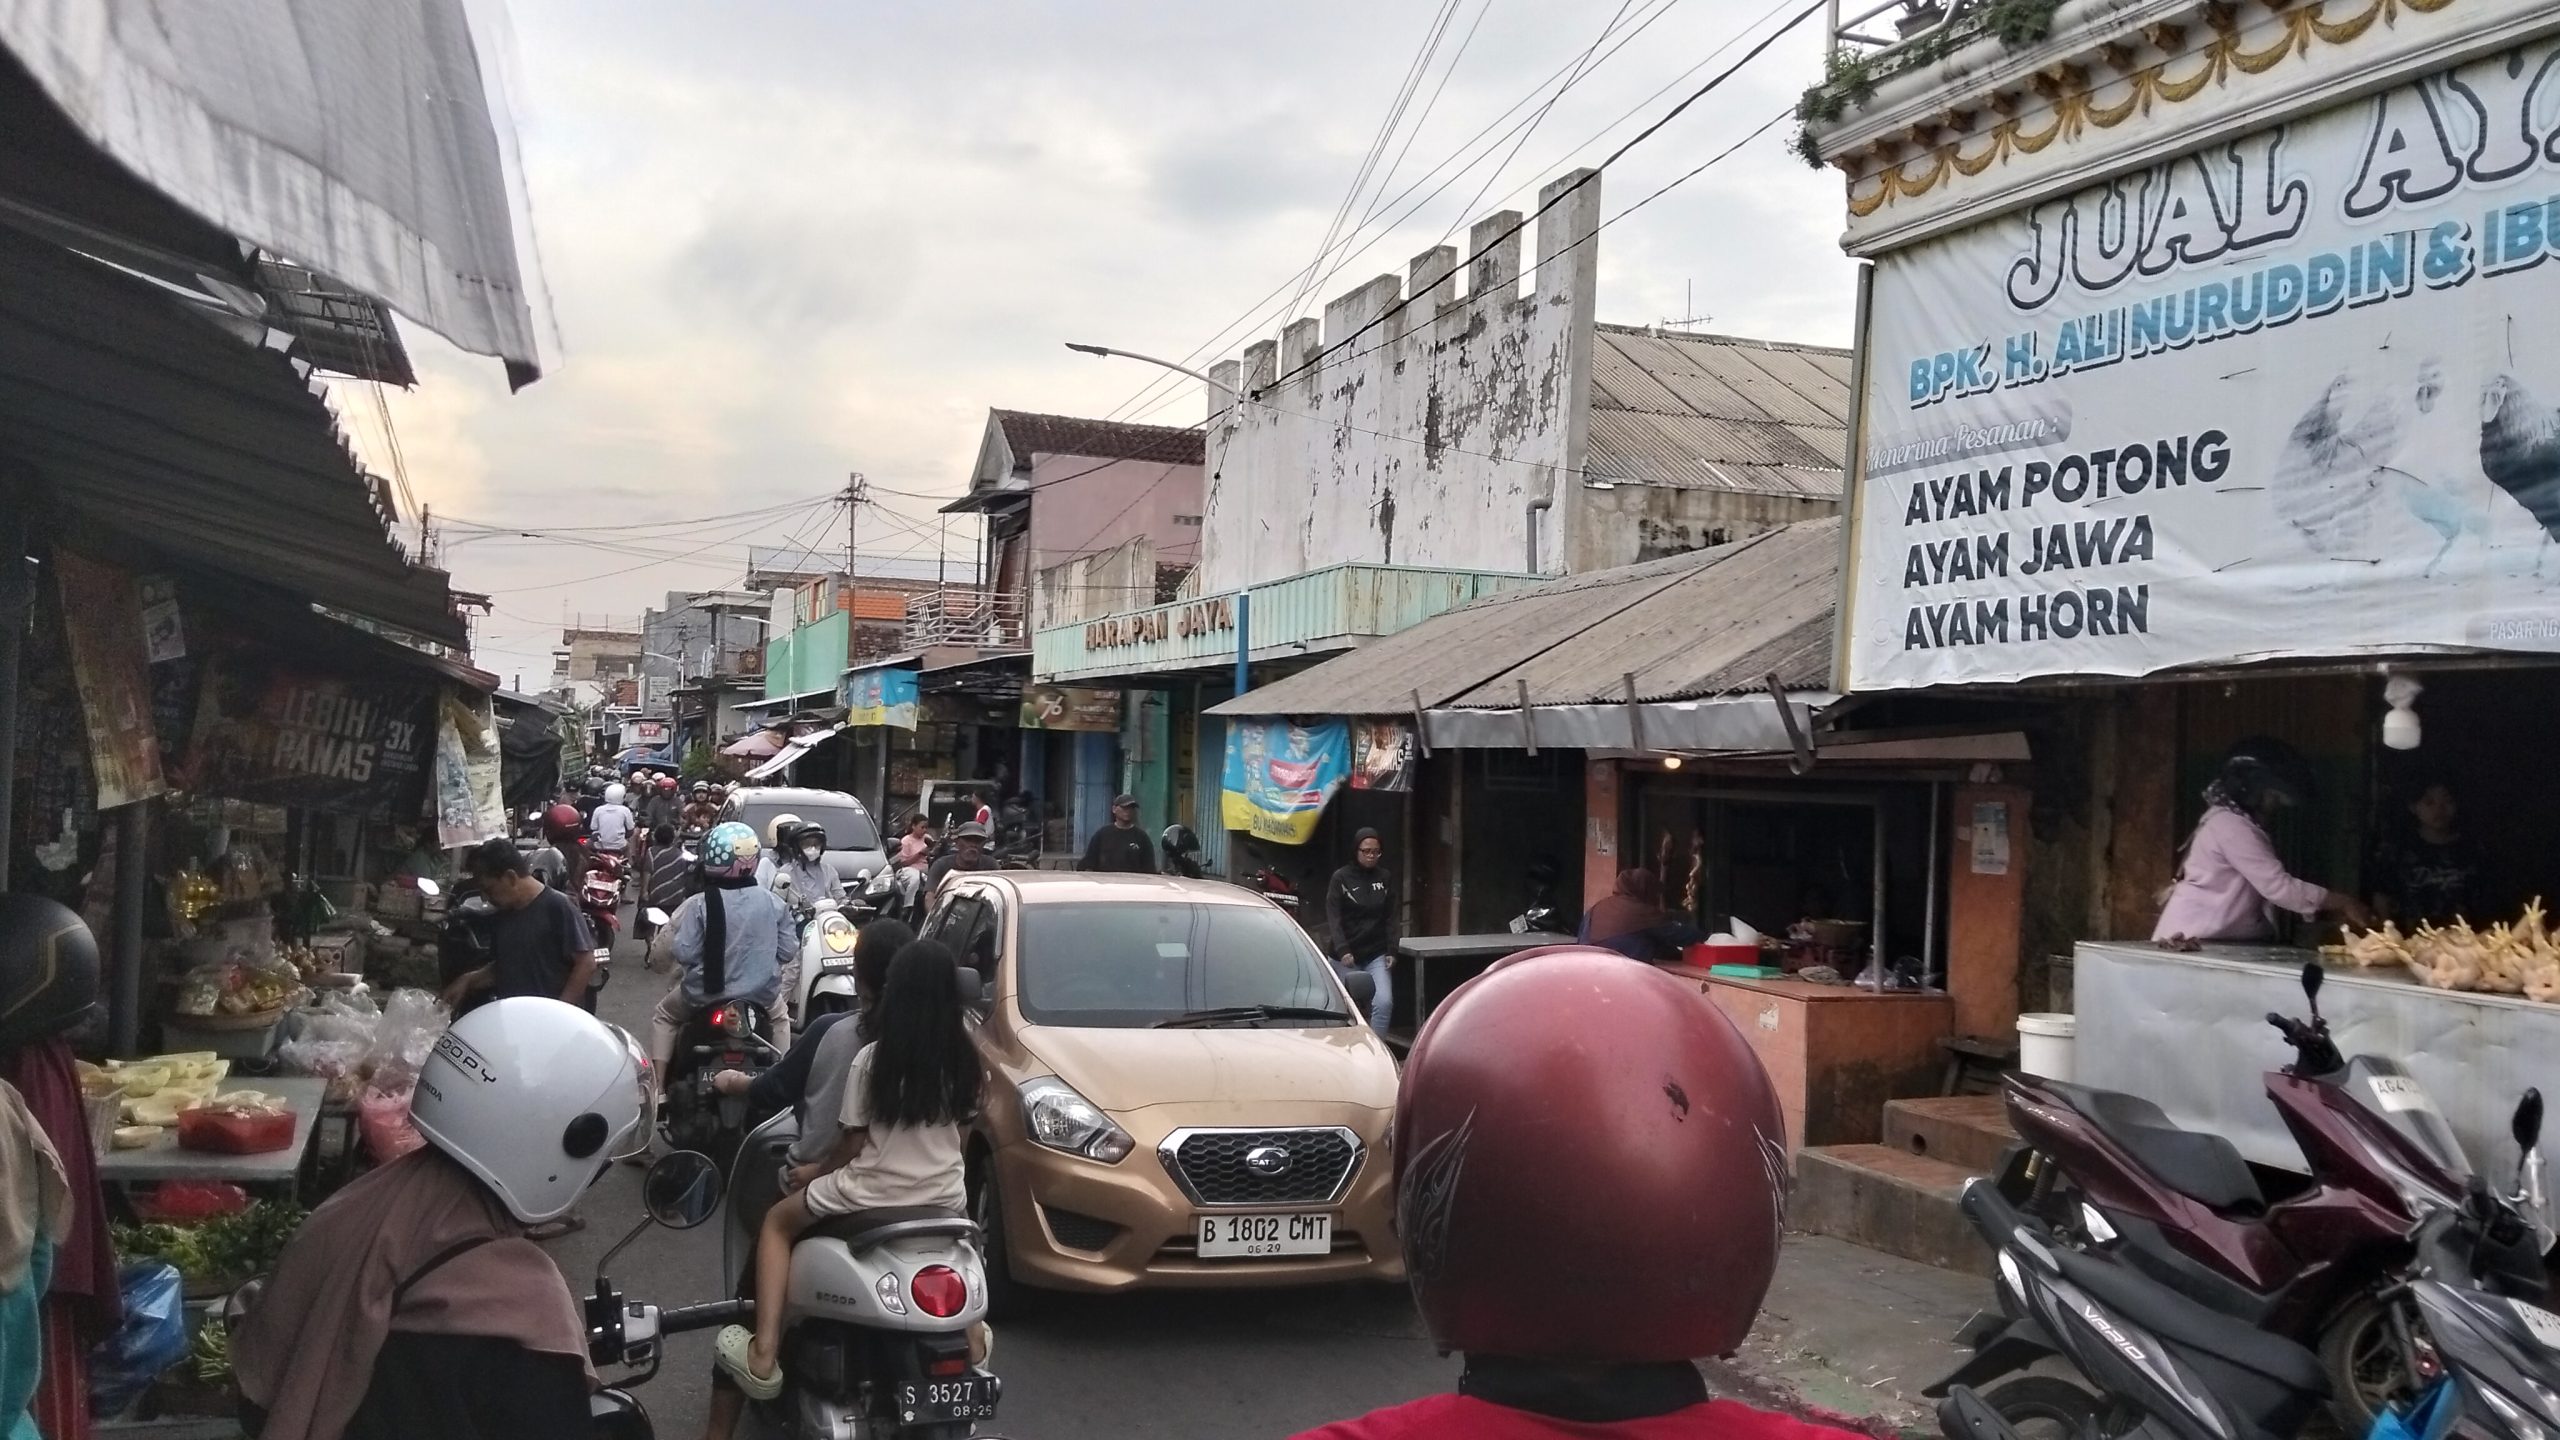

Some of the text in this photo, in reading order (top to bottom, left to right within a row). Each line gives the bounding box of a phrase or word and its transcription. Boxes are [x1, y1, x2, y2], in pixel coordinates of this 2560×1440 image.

[2007, 50, 2560, 309] JUAL AY
[1911, 346, 1996, 407] BPK.
[2005, 332, 2047, 387] H.
[2053, 307, 2123, 375] ALI
[2131, 231, 2414, 357] NURUDDIN
[2423, 221, 2475, 289] &
[1954, 417, 2046, 451] Pesanan
[1904, 430, 2231, 526] AYAM POTONG
[1904, 515, 2154, 588] AYAM JAWA
[1085, 598, 1234, 650] HARAPAN JAYA
[1904, 584, 2149, 650] AYAM HORN
[2490, 617, 2560, 640] PASAR NG
[283, 688, 370, 739] LEBIH
[1040, 695, 1064, 719] 76
[272, 729, 376, 783] PANAS
[384, 720, 416, 752] 3X
[1204, 1216, 1328, 1242] B 1802 CMT
[2084, 1305, 2146, 1360] VARIO
[906, 1386, 916, 1404] S
[929, 1382, 973, 1403] 3527
